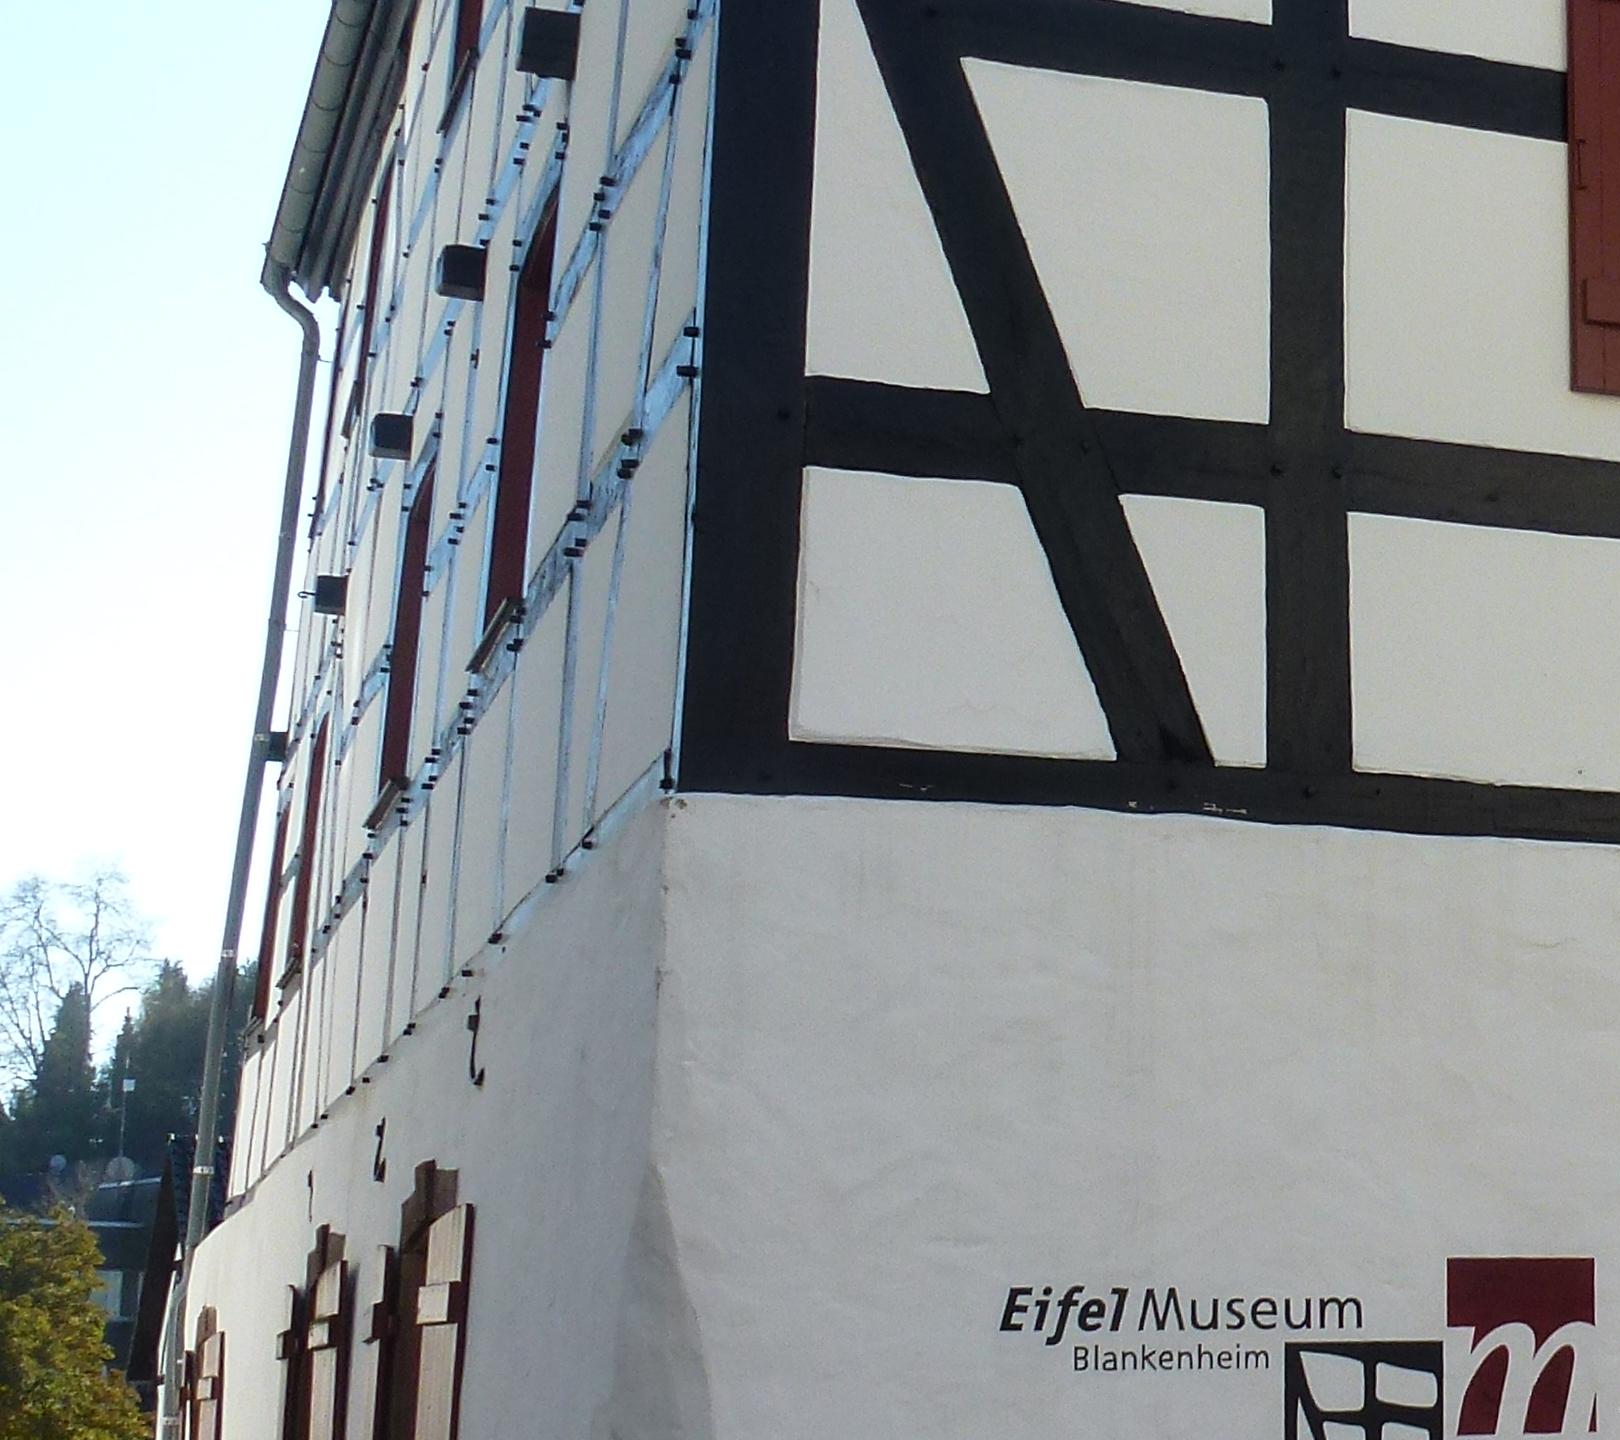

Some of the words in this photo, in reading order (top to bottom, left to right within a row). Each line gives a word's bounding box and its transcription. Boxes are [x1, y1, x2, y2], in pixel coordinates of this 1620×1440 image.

[999, 1285, 1129, 1346] Eifel
[1137, 1287, 1363, 1332] Museum
[1073, 1343, 1269, 1372] Blankenheim
